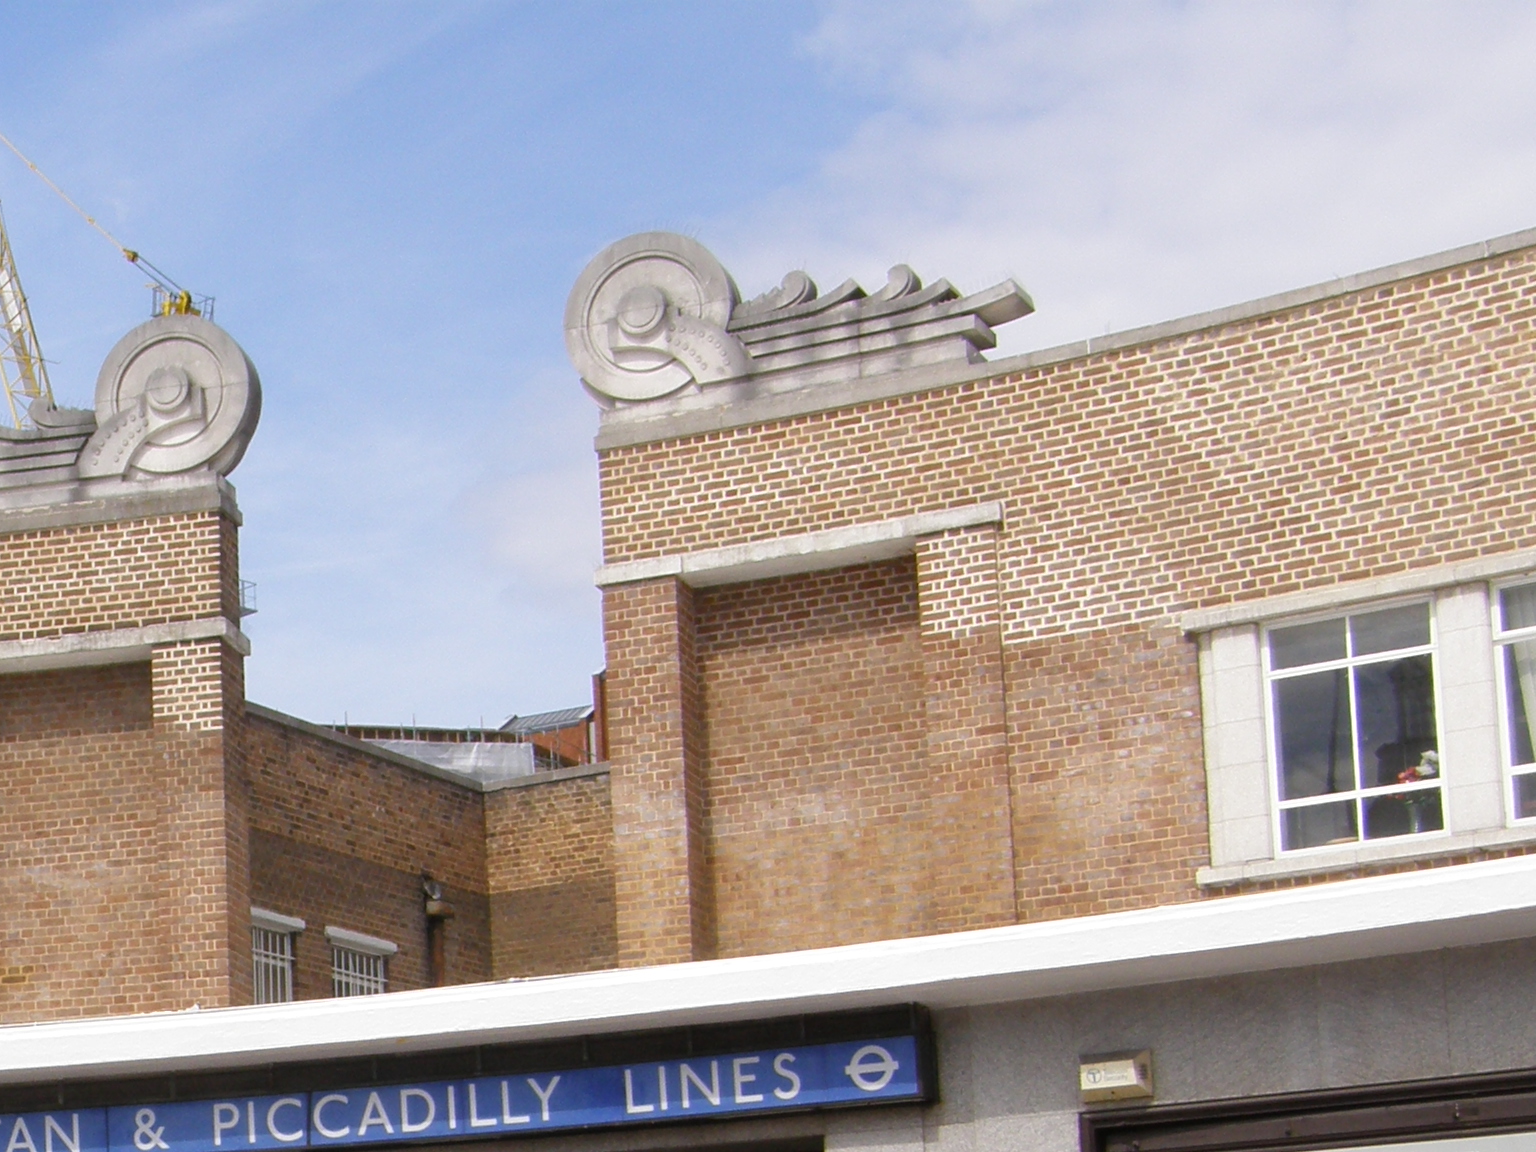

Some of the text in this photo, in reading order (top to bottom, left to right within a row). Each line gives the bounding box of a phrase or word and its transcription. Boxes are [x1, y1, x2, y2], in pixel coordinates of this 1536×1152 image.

[133, 1108, 170, 1151] &
[212, 1076, 562, 1146] PICCADILLY
[624, 1052, 802, 1115] LINES
